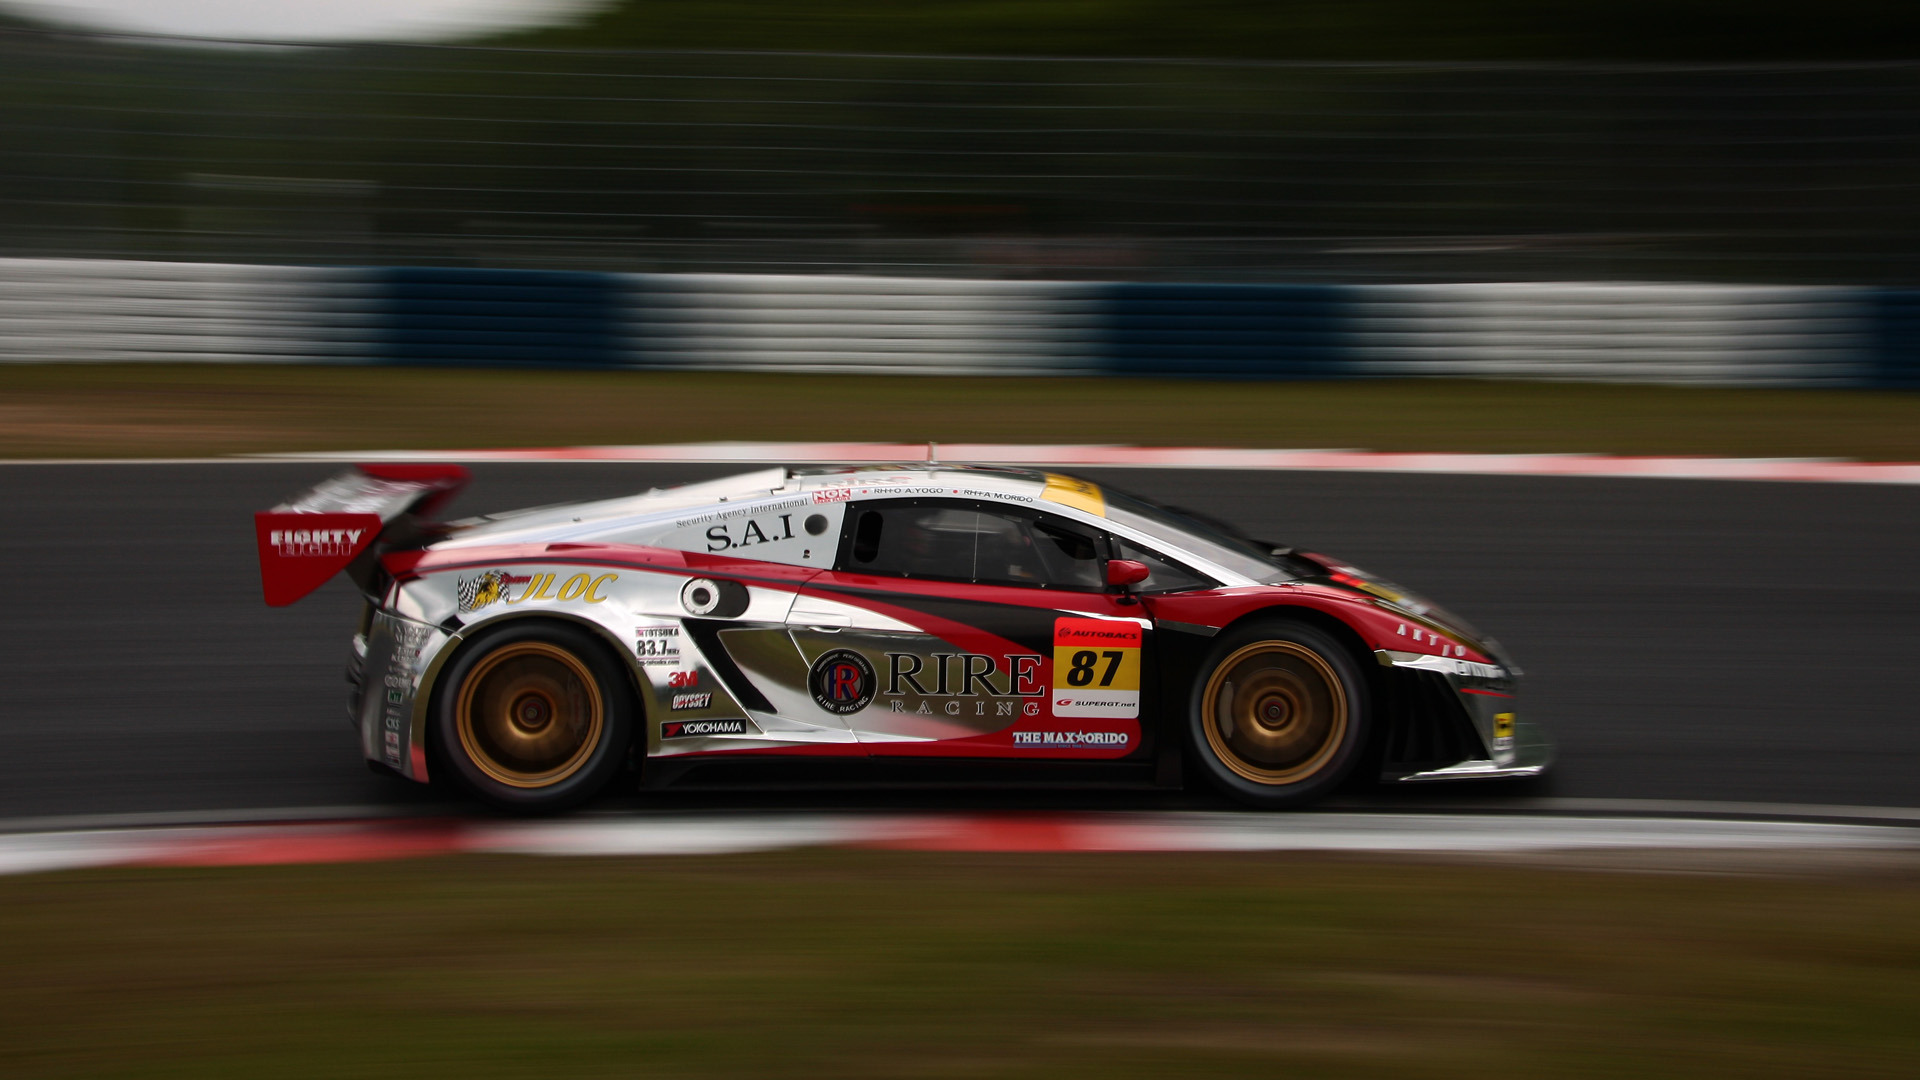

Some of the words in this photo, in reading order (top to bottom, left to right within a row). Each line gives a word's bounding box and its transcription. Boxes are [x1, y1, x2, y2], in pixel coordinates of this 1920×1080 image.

[813, 488, 851, 501] NGK
[994, 492, 1034, 503] M.ORIDO
[676, 513, 713, 528] Security
[715, 508, 748, 521] Agency
[750, 497, 808, 514] International
[270, 529, 363, 546] EIGHTY
[705, 513, 796, 552] S.A.I
[507, 572, 619, 604] JLOC
[1071, 629, 1137, 640] AUTOBACS
[883, 652, 1045, 698] RIRE
[1066, 650, 1124, 687] 87
[668, 669, 699, 688] 3M
[672, 691, 712, 710] ODYSSEY
[816, 694, 836, 711] RIRE
[890, 699, 1040, 717] RACING
[1074, 700, 1136, 708] SUPERGT.net
[682, 721, 742, 734] YOKOHAMA
[1012, 731, 1042, 744] THE
